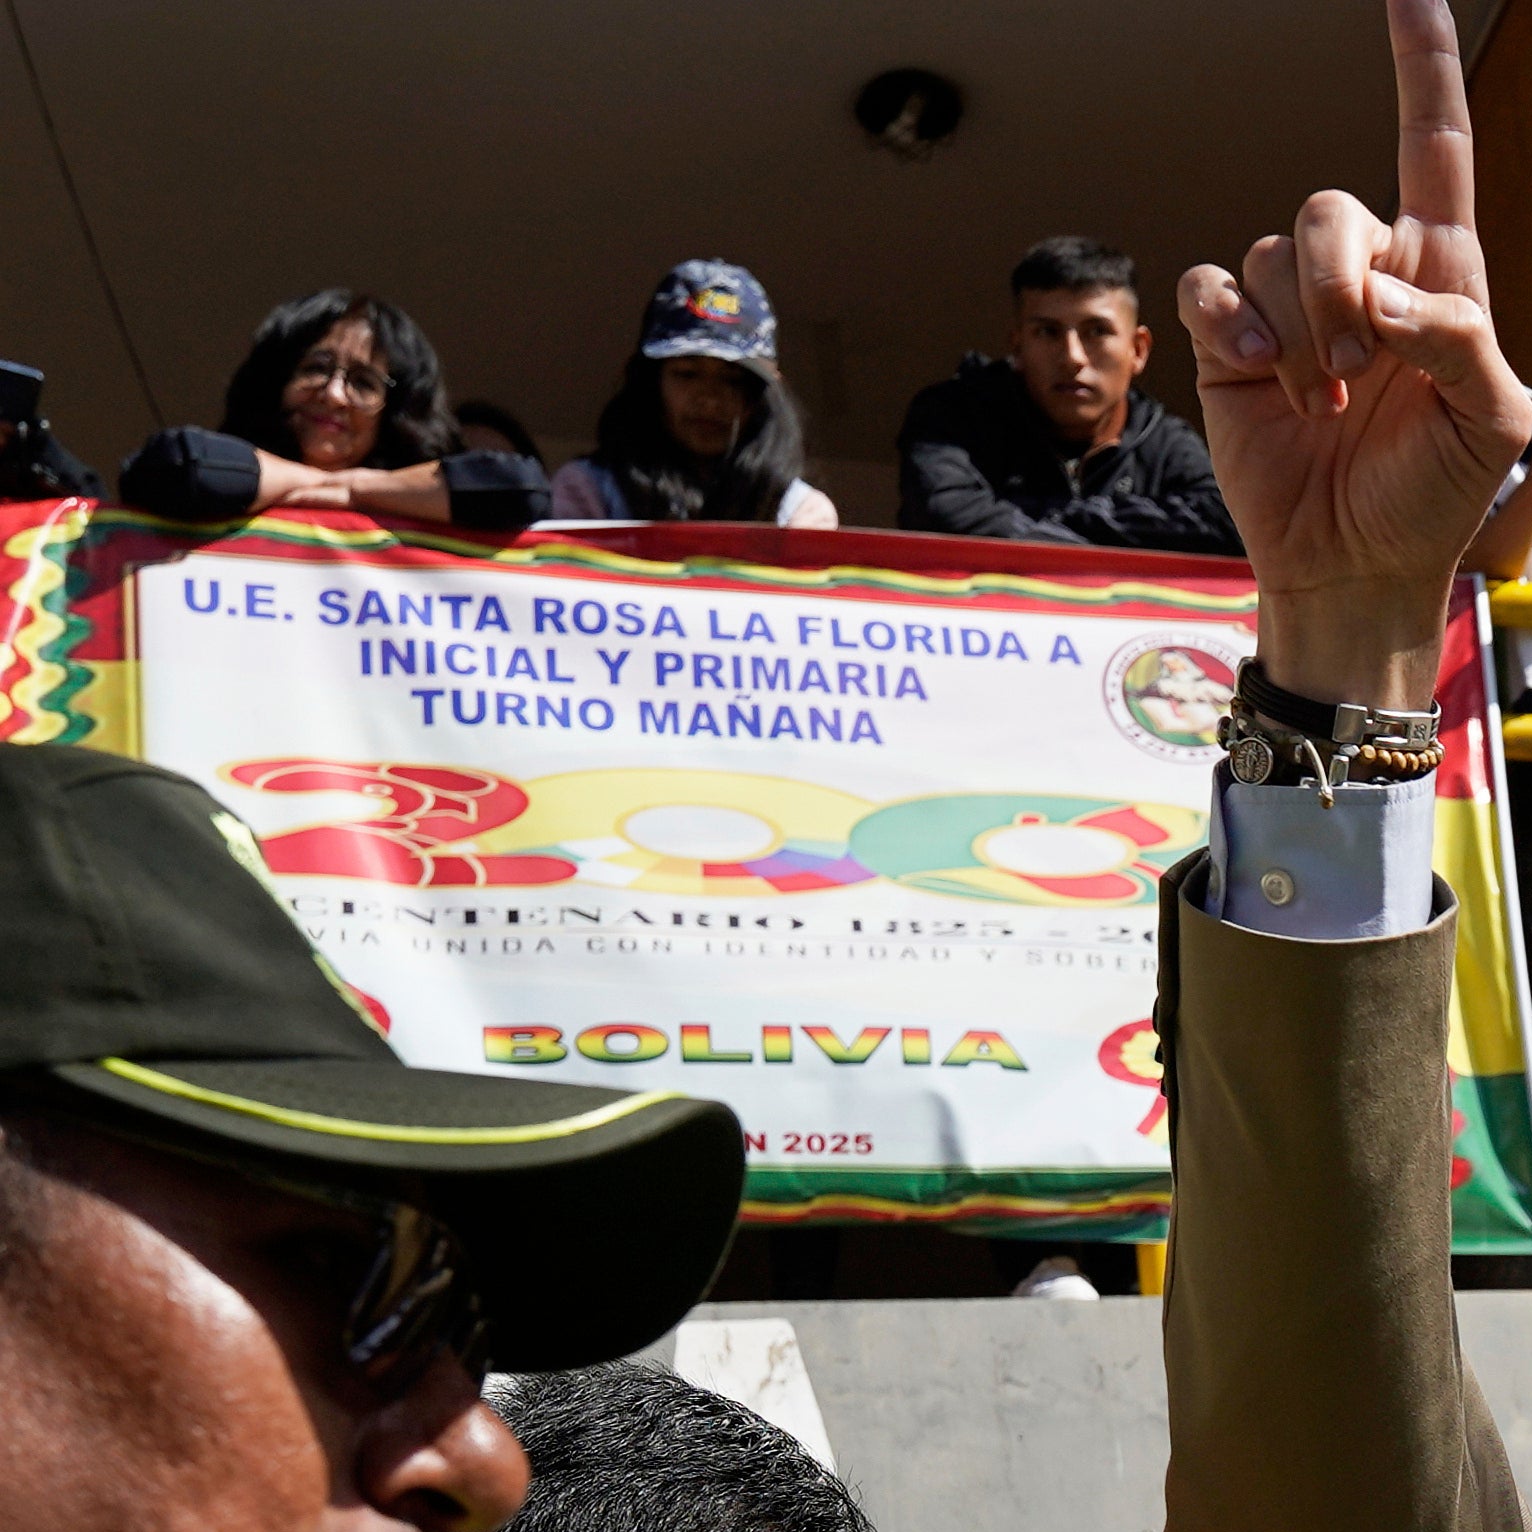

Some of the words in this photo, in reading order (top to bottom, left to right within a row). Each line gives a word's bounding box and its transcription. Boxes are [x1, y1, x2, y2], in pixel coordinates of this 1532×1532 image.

[183, 578, 294, 621] U.E.
[318, 589, 510, 633] SANTA
[533, 596, 687, 638] ROSA
[708, 609, 776, 643] LA
[799, 615, 1029, 662] FLORIDA
[1049, 633, 1083, 665] A
[360, 639, 575, 684] INICIAL
[598, 649, 630, 685] Y
[655, 651, 929, 701] PRIMARIA
[411, 689, 615, 730] TURNO
[639, 694, 884, 745] MAÑANA
[290, 896, 804, 933] CENTENARIO
[411, 935, 557, 955] UNIDA
[586, 937, 673, 955] CON
[705, 939, 951, 962] IDENTIDAD
[1025, 948, 1157, 972] SOBER
[482, 1022, 1030, 1072] BOLIVIA
[783, 1131, 874, 1155] 2025
